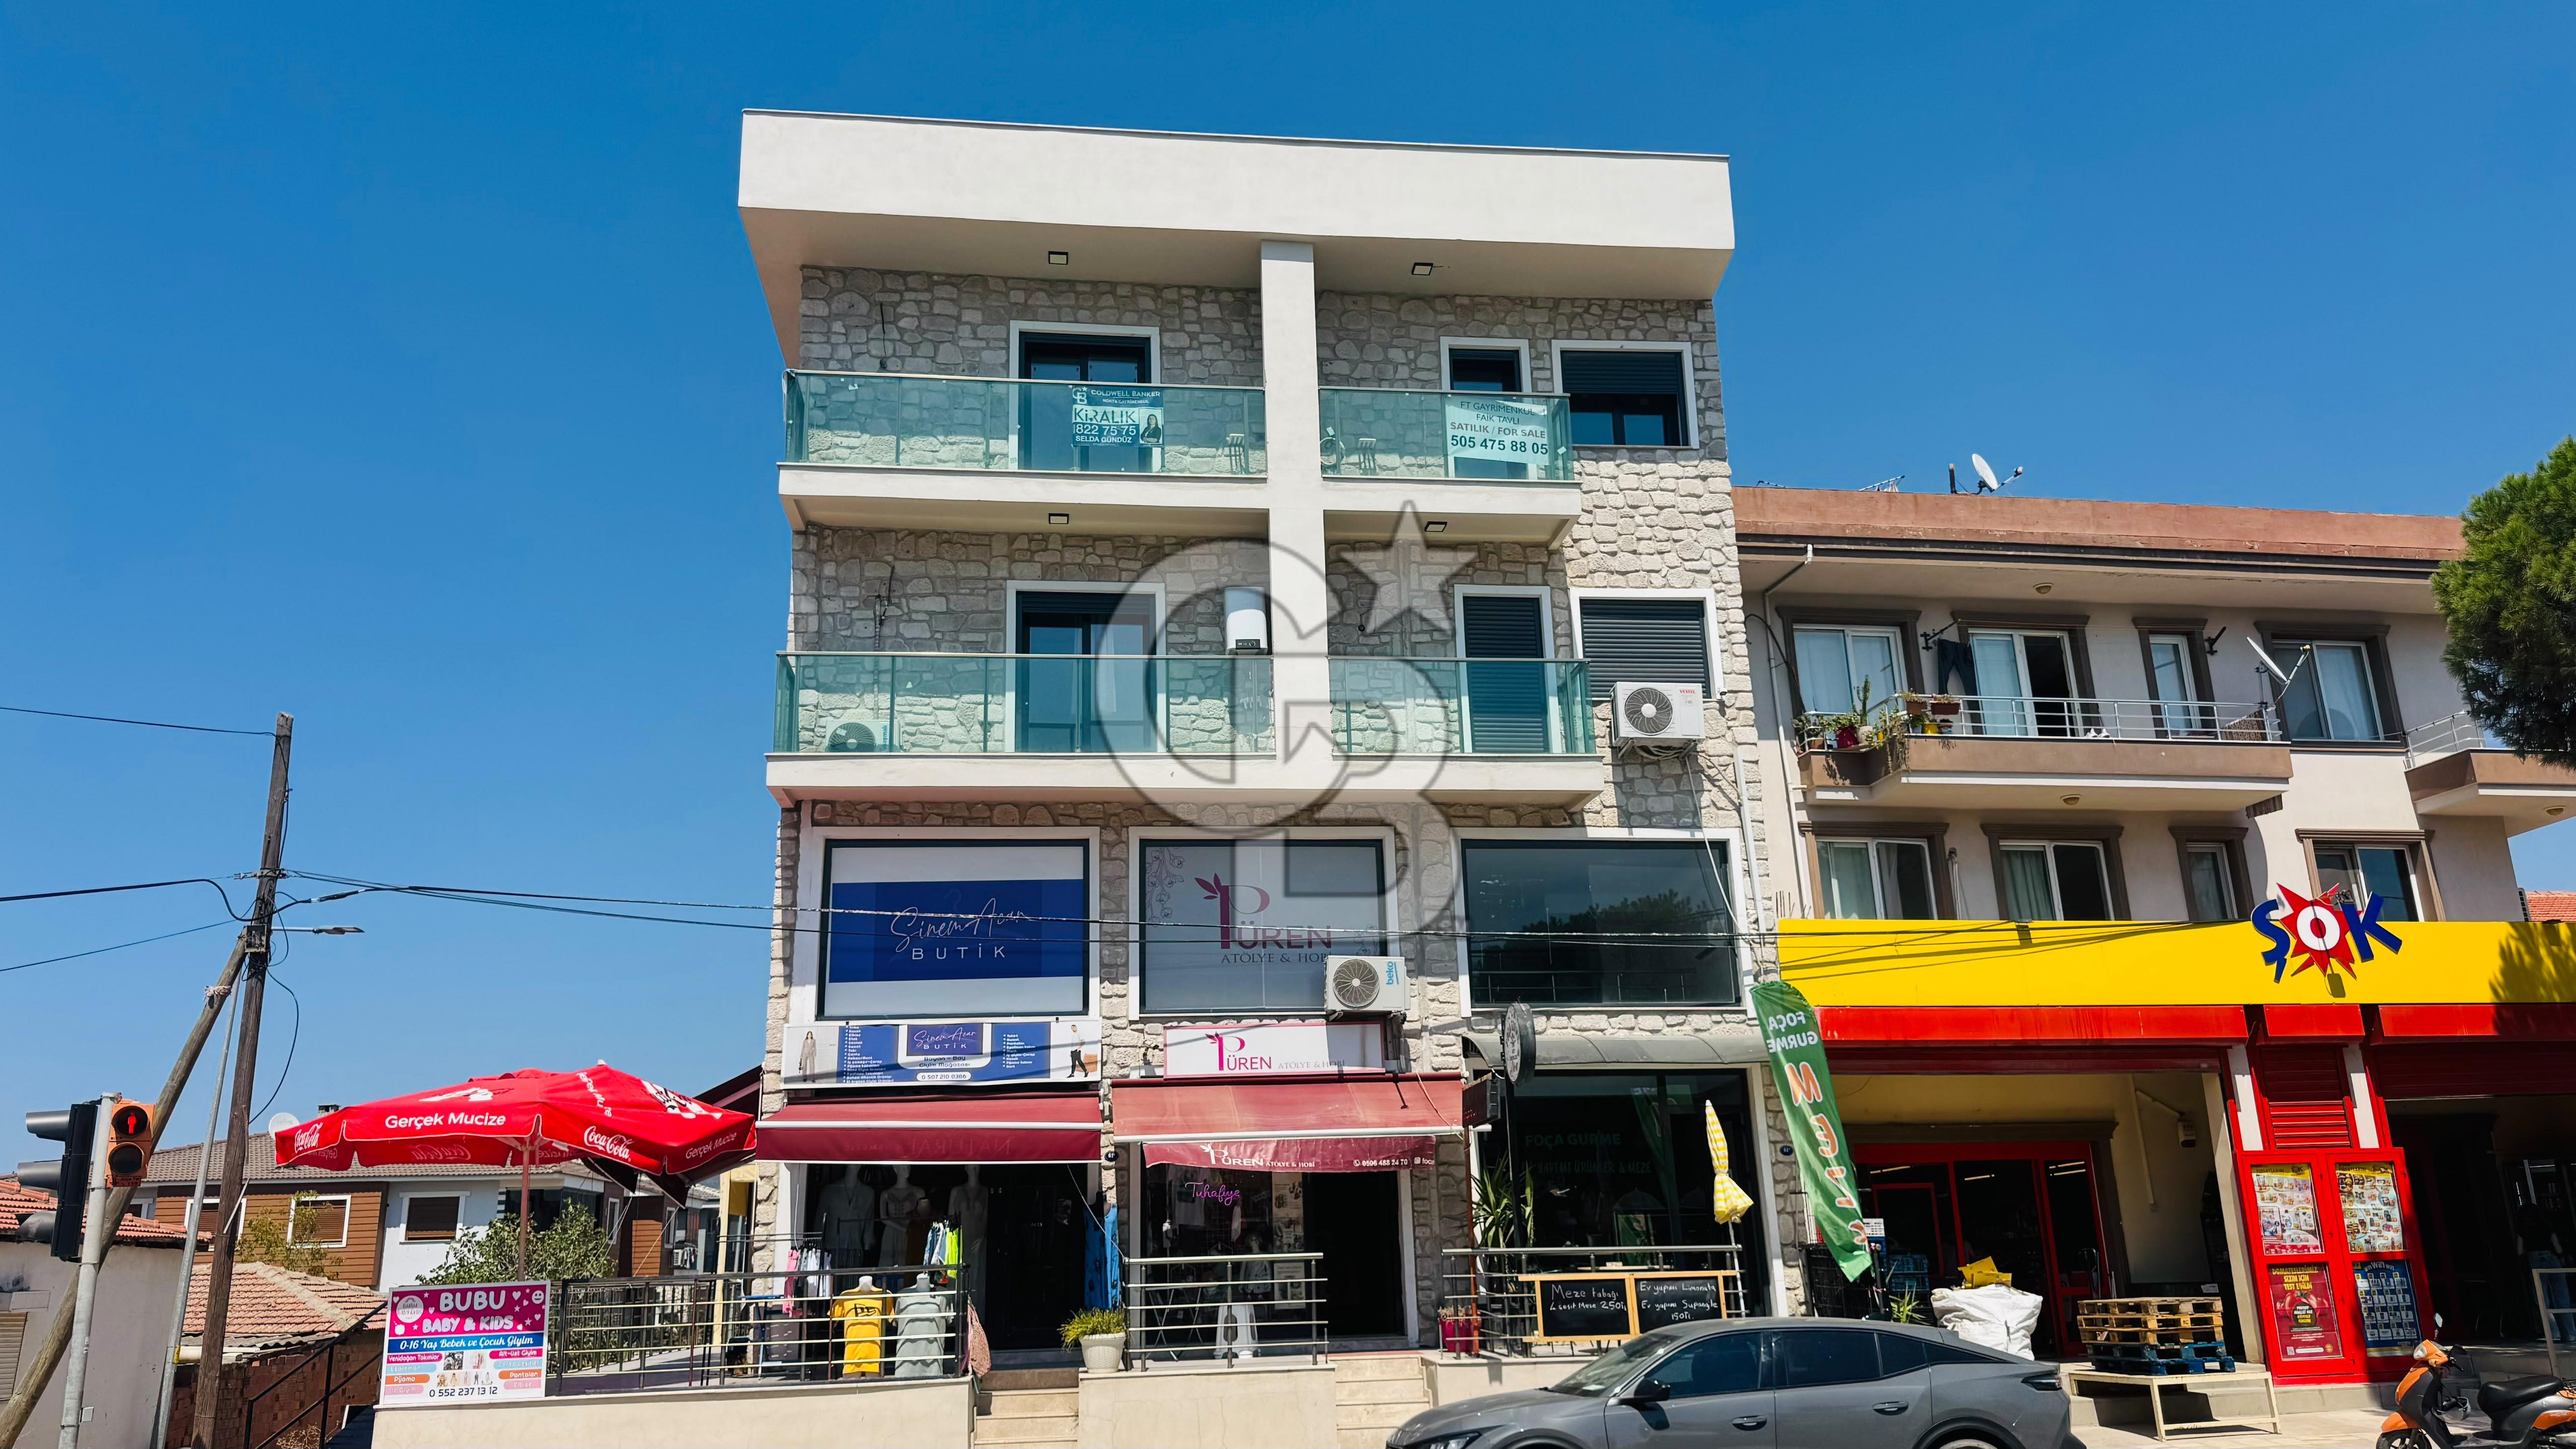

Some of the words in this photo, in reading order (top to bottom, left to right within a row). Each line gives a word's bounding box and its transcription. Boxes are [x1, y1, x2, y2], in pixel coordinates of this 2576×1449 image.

[1461, 401, 1471, 409] FT
[1473, 402, 1536, 416] GAYRİMENKUL
[1476, 413, 1495, 422] FAİK
[1496, 415, 1520, 425] TAVLI
[1076, 424, 1099, 435] 822
[1102, 426, 1118, 436] 75
[1120, 426, 1137, 436] 75
[1450, 422, 1489, 434] SATILIK
[1497, 427, 1518, 436] FOR
[1521, 429, 1546, 439] SALE
[1451, 435, 1476, 448] 505
[1480, 438, 1506, 450] 475
[1510, 440, 1526, 453] 88
[1532, 442, 1549, 455] 05
[1210, 881, 1332, 949] PÜREN
[891, 906, 969, 952] Sinem
[2250, 891, 2403, 984] ŞOK
[912, 942, 1006, 960] BUTİK
[1221, 951, 1275, 964] ATÖLYE
[1279, 952, 1291, 963] &
[1385, 960, 1394, 985] beko
[914, 1030, 948, 1047] Sinem
[1211, 1033, 1272, 1072] PÜREN
[1322, 1059, 1346, 1068] HOBİ
[385, 1113, 444, 1130] Gerçek
[447, 1111, 507, 1128] Mucize
[685, 1141, 712, 1159] Gerçek
[713, 1132, 738, 1150] Mucize
[1525, 1134, 1566, 1150] FOÇA
[1566, 1133, 1622, 1147] GURME
[1185, 1182, 1240, 1206] Tuhafiye
[1551, 1284, 1586, 1301] Meze
[1640, 1281, 1652, 1292] Ev
[1682, 1282, 1717, 1292] Limonata
[439, 1290, 506, 1312] BUBU
[1641, 1300, 1652, 1309] Ev
[422, 1317, 460, 1333] BABY
[463, 1317, 476, 1332] &
[479, 1315, 514, 1331] KIDS
[399, 1338, 419, 1350] 0-16
[420, 1339, 437, 1351] Yaş
[440, 1337, 466, 1348] Bebek
[478, 1336, 505, 1349] Çocuk
[507, 1333, 534, 1346] Giyim
[521, 1349, 537, 1357] Giyim
[394, 1376, 416, 1384] Pijama
[429, 1389, 435, 1398] 0
[438, 1388, 456, 1397] 552
[458, 1387, 474, 1396] 237
[477, 1387, 486, 1396] 13
[489, 1386, 498, 1395] 12
